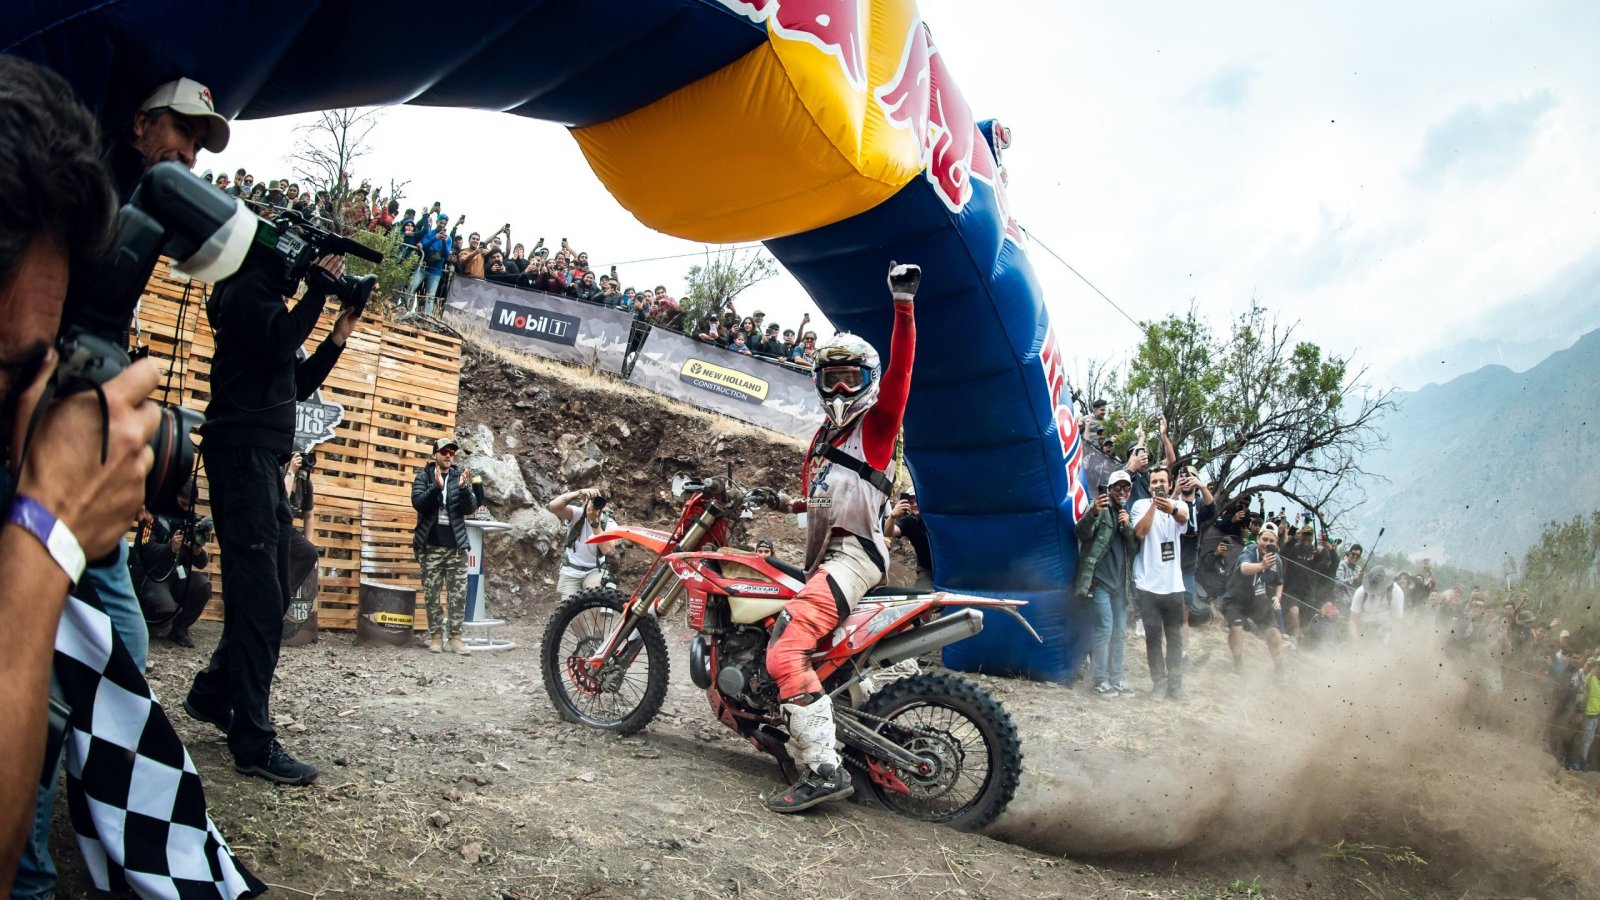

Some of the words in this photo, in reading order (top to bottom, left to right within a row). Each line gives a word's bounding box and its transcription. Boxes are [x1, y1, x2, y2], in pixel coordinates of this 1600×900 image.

[499, 308, 548, 333] Mobil
[693, 379, 748, 400] CONSTRUCTION
[702, 368, 723, 380] NEW
[722, 375, 762, 392] HOLLAND
